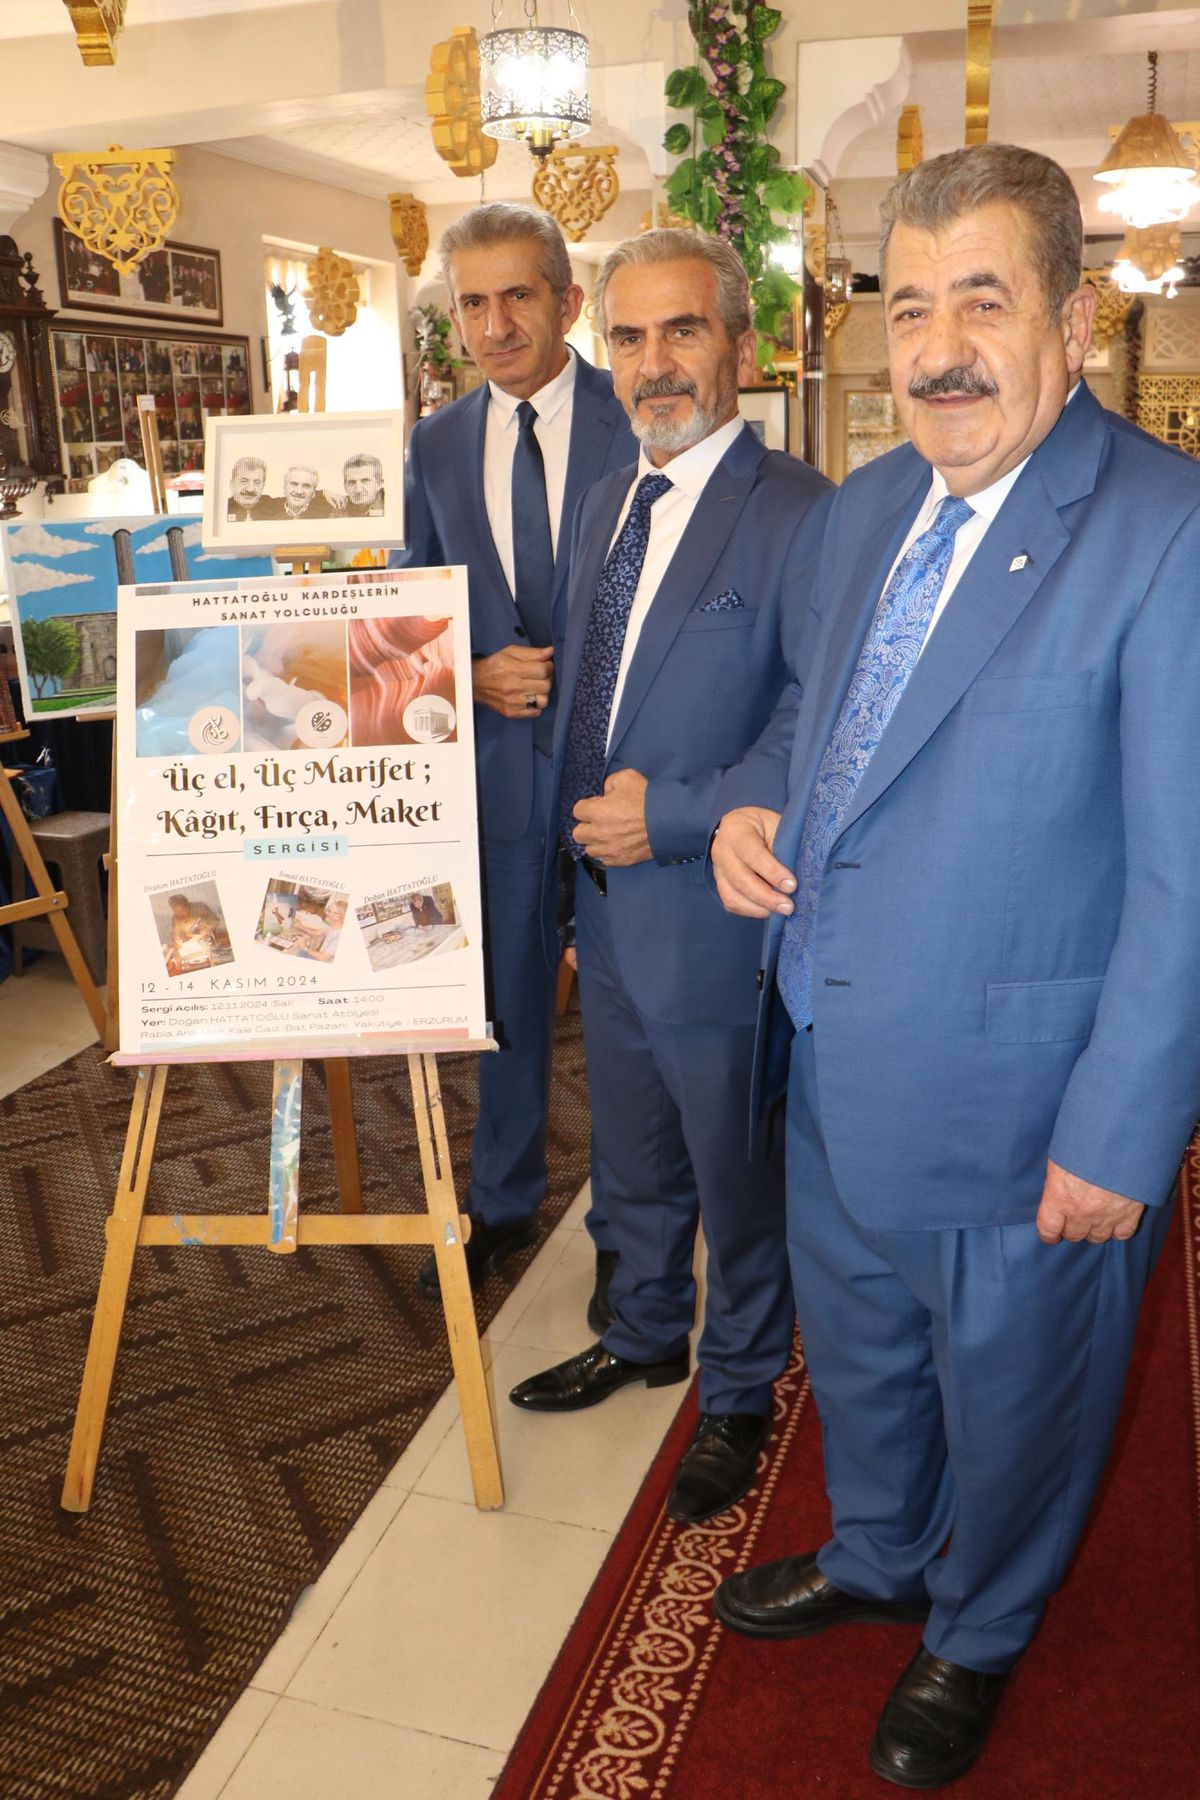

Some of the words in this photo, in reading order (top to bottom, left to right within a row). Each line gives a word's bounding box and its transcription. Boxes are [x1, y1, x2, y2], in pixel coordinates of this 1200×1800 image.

[193, 591, 289, 607] HATTATOĞLU
[302, 586, 400, 601] KARDEŞLERİN
[221, 610, 268, 621] SANAT
[274, 605, 359, 619] YOLCULUĞU
[162, 763, 205, 798] Üç
[214, 764, 246, 793] el,
[254, 758, 297, 793] Üç
[304, 754, 416, 789] Marifet
[156, 808, 246, 840] Kâğıt,
[254, 805, 338, 835] Fırça,
[346, 794, 443, 828] Maket
[253, 841, 340, 855] SERGİSİ
[141, 982, 156, 993] 12
[179, 981, 195, 991] 14
[210, 977, 267, 990] KASIM
[277, 976, 317, 987] 2024
[141, 1004, 173, 1014] Sergi
[175, 1003, 208, 1013] Açılış:
[141, 1018, 166, 1027] Yer:
[169, 1017, 208, 1027] Doğan
[210, 1012, 289, 1024] HATTATOĞLU
[292, 1010, 328, 1020] Sanat
[413, 1016, 469, 1026] ERZURUM
